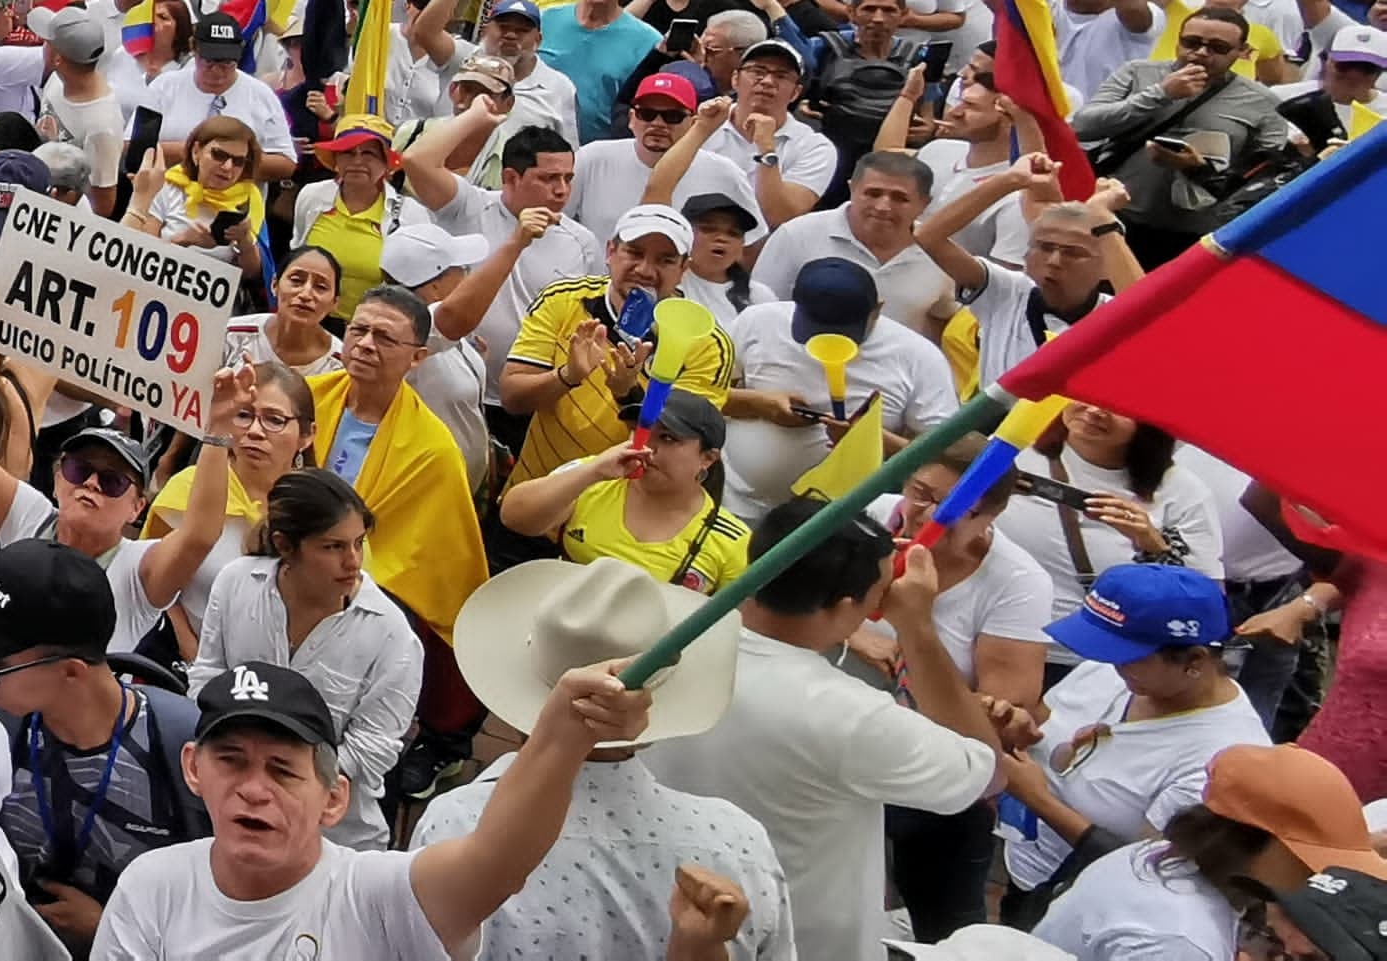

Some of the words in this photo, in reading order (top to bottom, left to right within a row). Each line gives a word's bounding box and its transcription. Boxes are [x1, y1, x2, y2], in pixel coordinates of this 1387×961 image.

[13, 202, 62, 244] CNE
[67, 221, 85, 252] Y
[88, 231, 230, 308] CONGRESO
[4, 260, 97, 337] ART.
[111, 289, 200, 374] 109
[61, 346, 163, 409] POLÍTICO
[170, 380, 202, 429] YA
[230, 665, 269, 701] LA
